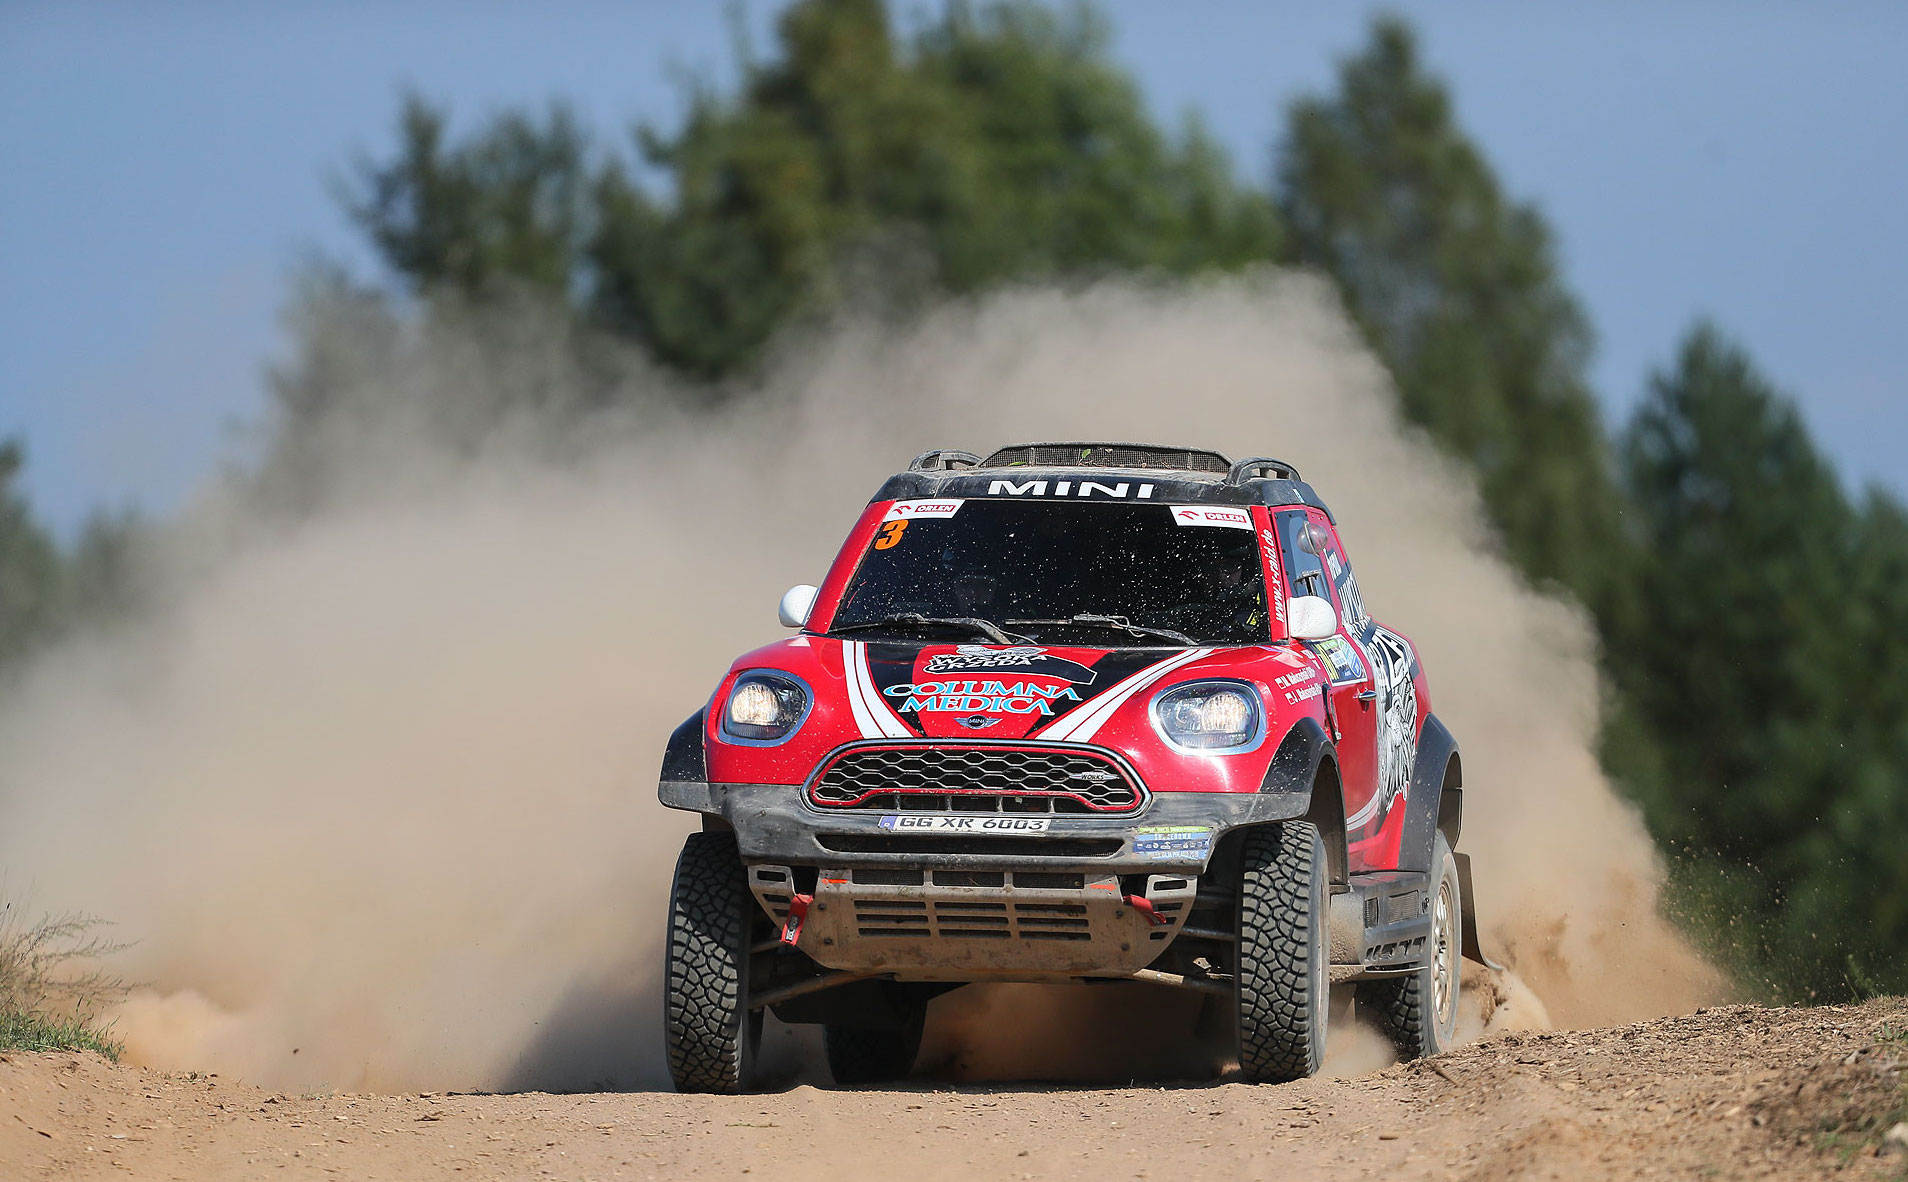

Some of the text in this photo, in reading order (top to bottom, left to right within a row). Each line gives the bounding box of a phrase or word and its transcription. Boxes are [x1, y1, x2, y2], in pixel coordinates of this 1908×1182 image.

[988, 481, 1154, 498] MINI
[1207, 513, 1246, 522] ORLEN
[874, 519, 909, 551] 3
[1263, 529, 1285, 623] www.x-raid.de
[884, 681, 1083, 701] COLUMNA
[899, 697, 1055, 716] MEDICA
[900, 817, 1044, 830] GG XR 6003
